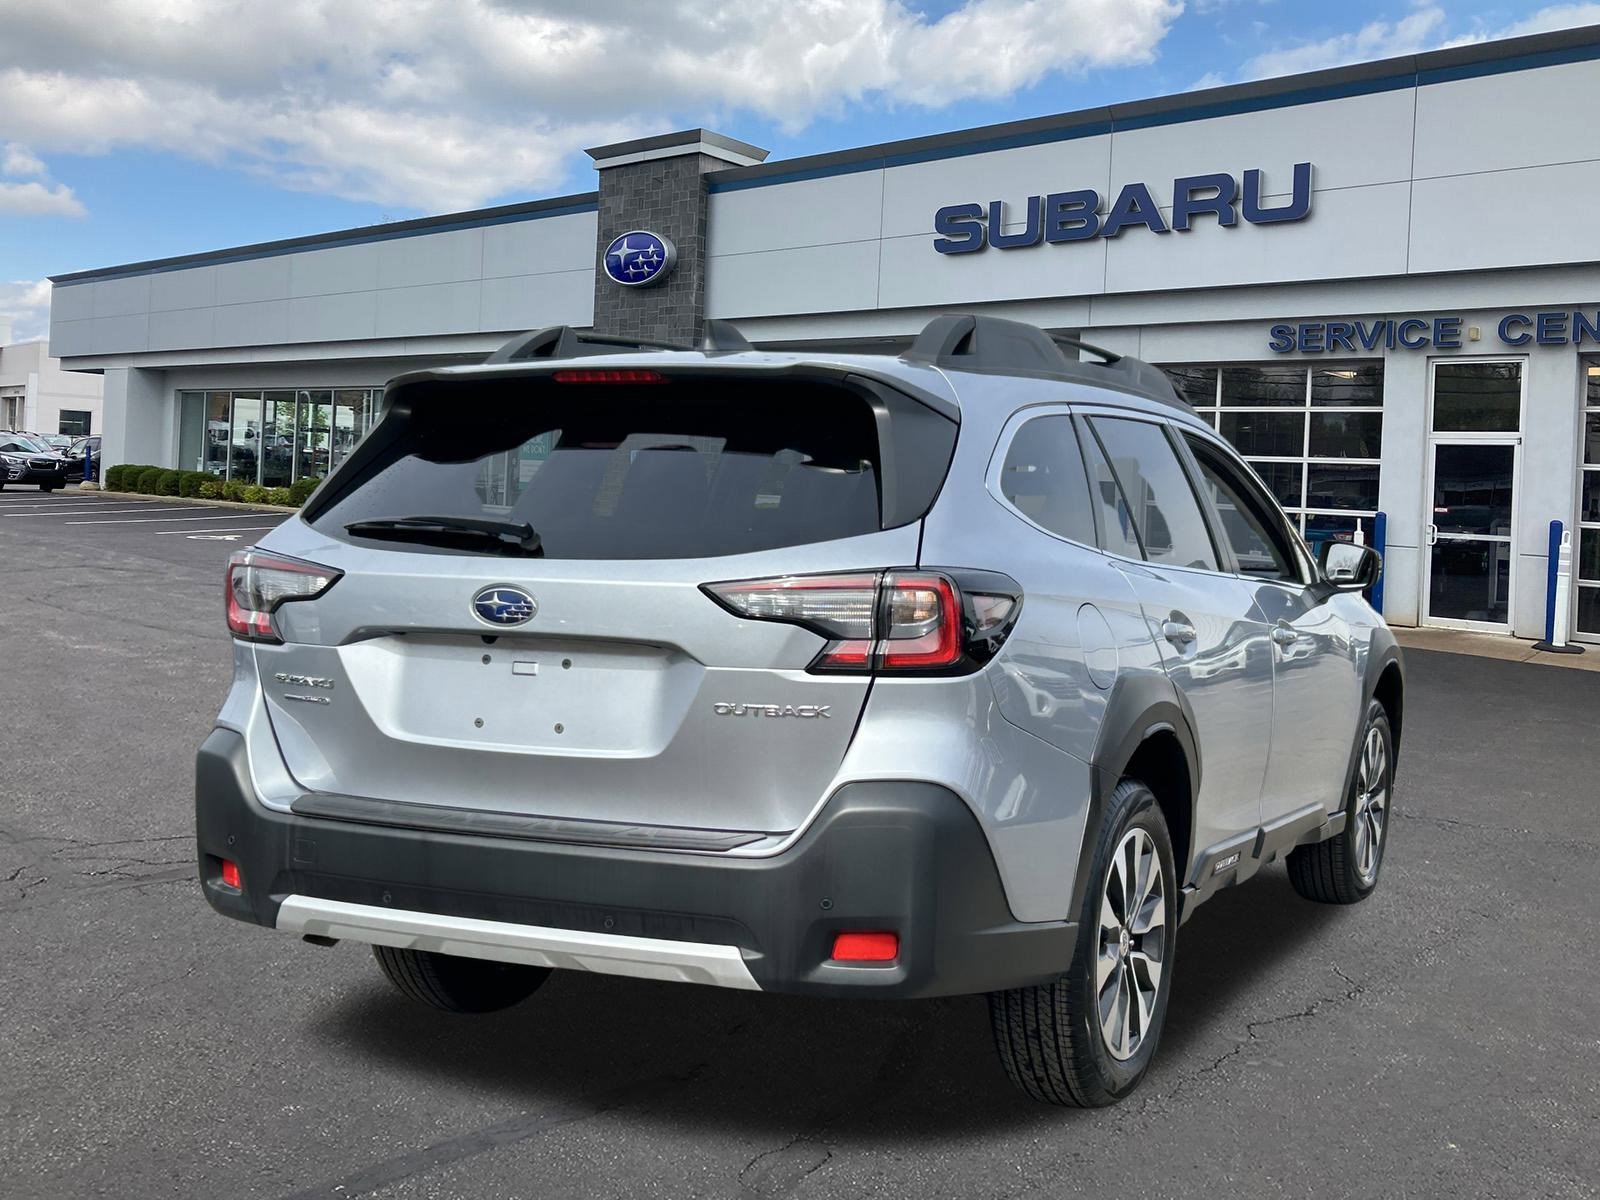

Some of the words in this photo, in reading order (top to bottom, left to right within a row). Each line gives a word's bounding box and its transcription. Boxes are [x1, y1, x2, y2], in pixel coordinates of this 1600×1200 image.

[934, 162, 1314, 255] SUBARU
[1269, 317, 1464, 353] SERVICE
[1497, 311, 1600, 346] CEN
[713, 702, 832, 719] OUTBACK
